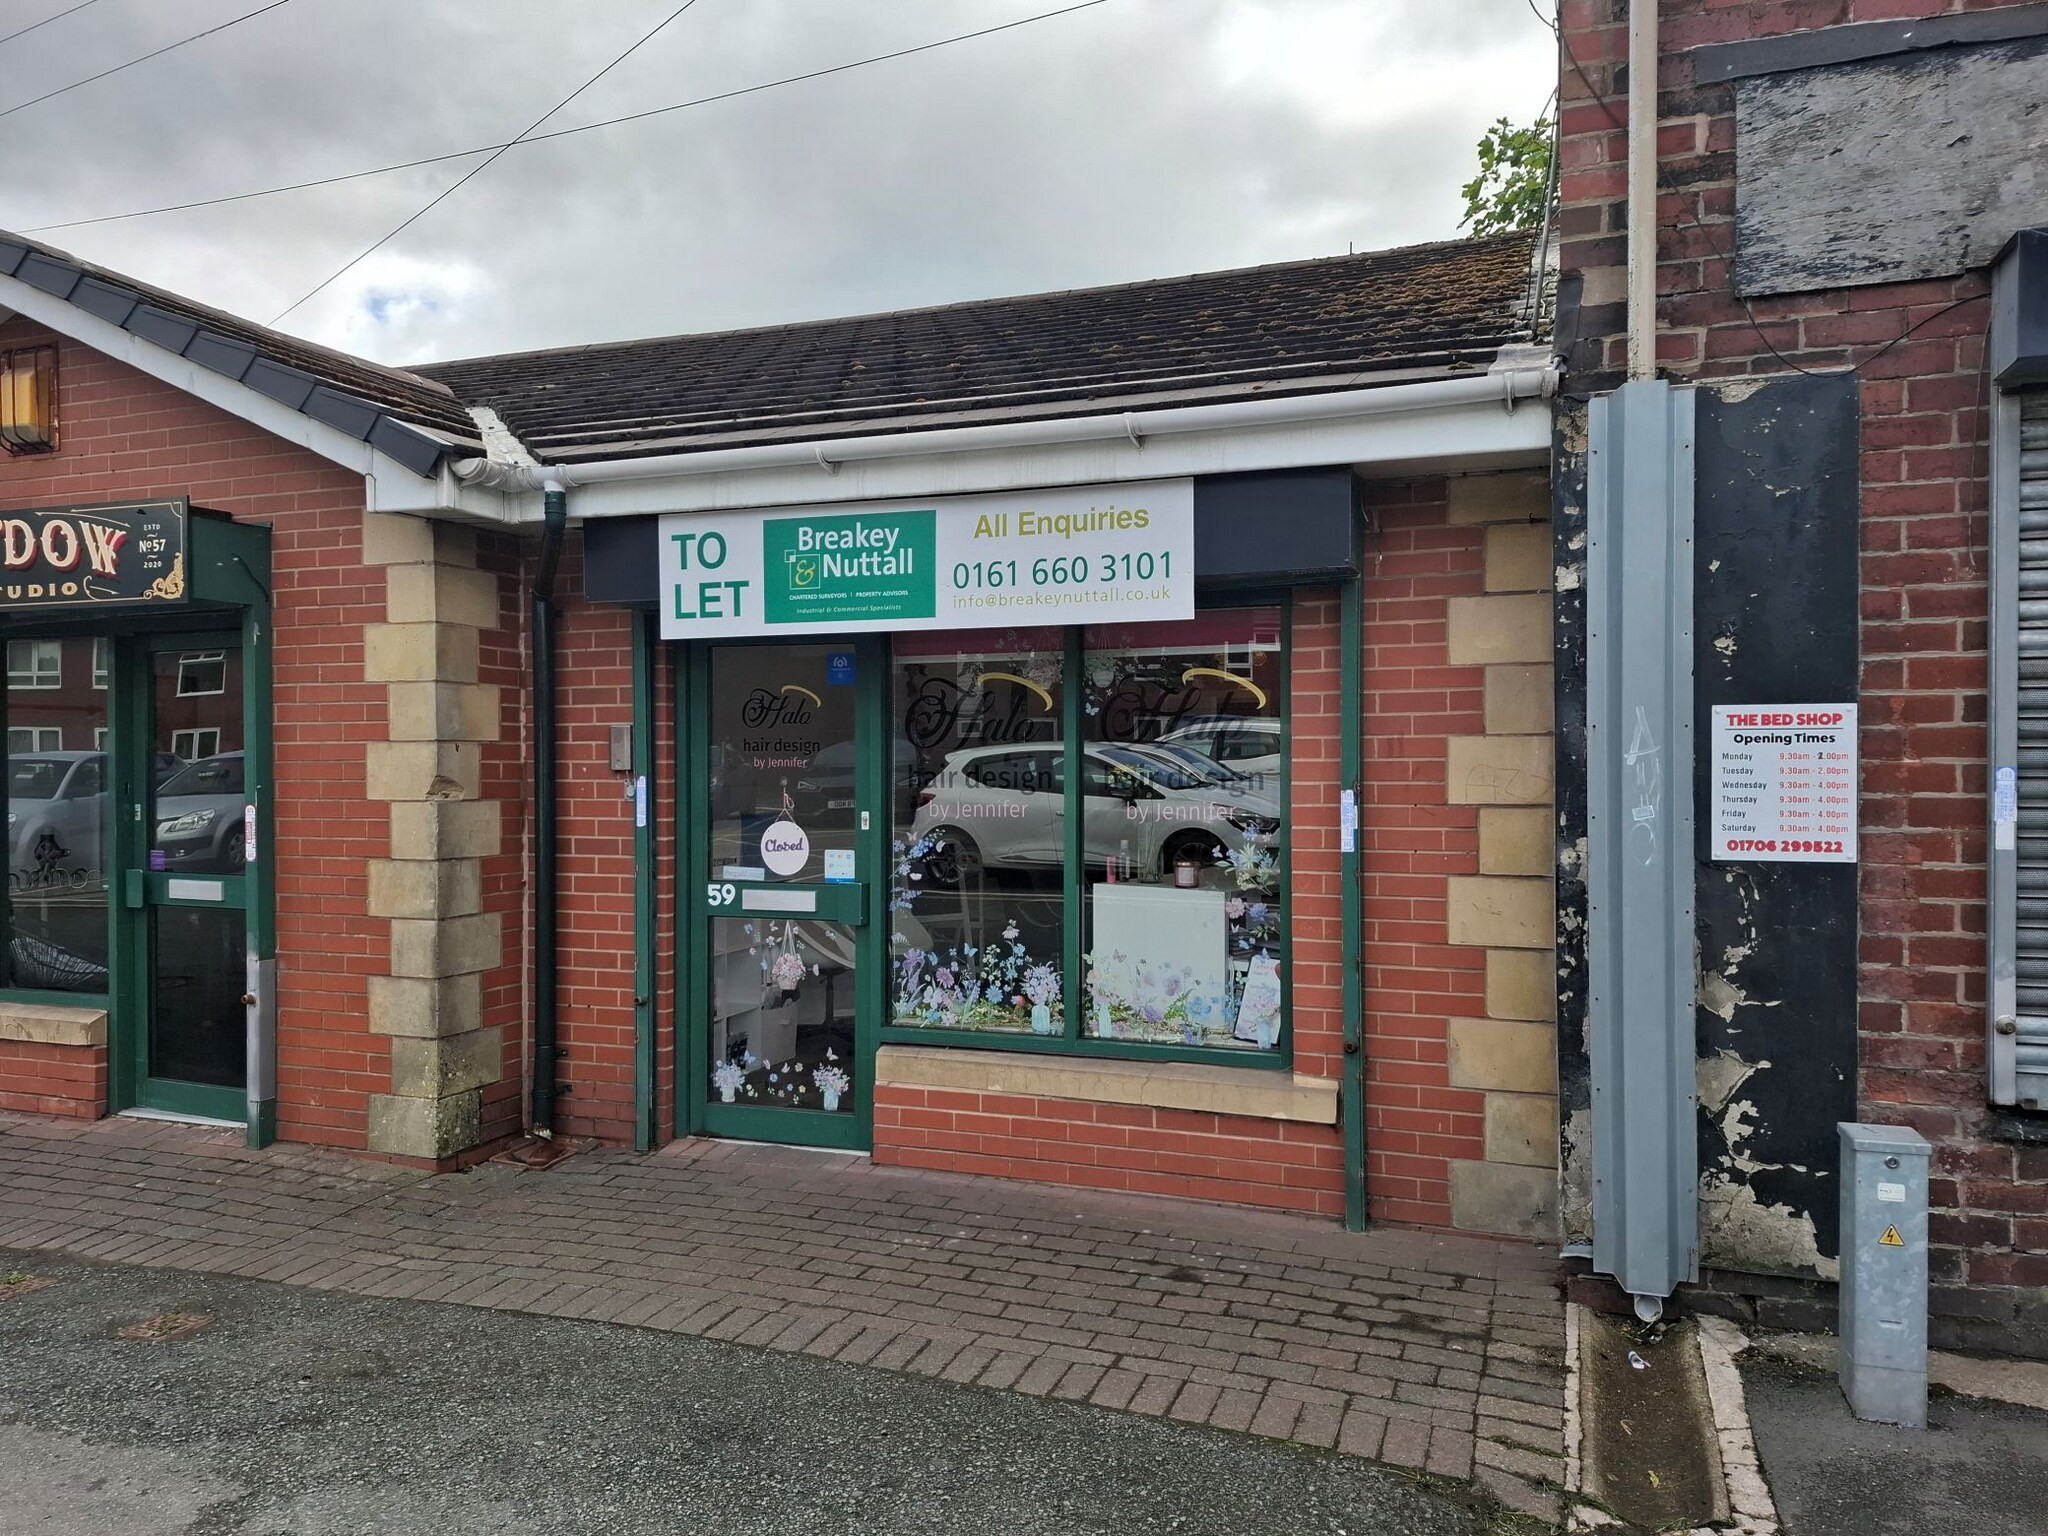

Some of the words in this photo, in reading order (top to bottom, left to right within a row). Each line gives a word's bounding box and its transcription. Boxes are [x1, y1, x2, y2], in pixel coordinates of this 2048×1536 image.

[973, 513, 1008, 539] All
[1018, 505, 1150, 539] Enquiries
[0, 519, 126, 576] DOW
[798, 521, 900, 554] Breakey
[671, 531, 727, 570] TO
[143, 560, 162, 569] 2020
[795, 559, 816, 586] &
[823, 548, 913, 578] Nuttall
[953, 560, 1017, 589] 0161
[1032, 555, 1089, 586] 660
[1100, 551, 1171, 582] 3101
[0, 582, 78, 599] UDIO
[674, 580, 750, 620] LET
[789, 593, 818, 601] CHARTERED
[818, 592, 848, 600] SURVEYORS
[855, 591, 881, 599] PROPERTY
[882, 589, 909, 597] ADVISORS
[953, 585, 1171, 609] info@breakeynuttall.co.uk
[833, 605, 869, 613] Commercial
[869, 604, 901, 613] Specialists
[742, 688, 813, 729] Halo
[904, 677, 1044, 749] Halo
[1101, 674, 1253, 745] Halo
[1726, 714, 1759, 726] THE
[1761, 713, 1794, 726] BED
[1796, 713, 1843, 726] SHOP
[743, 737, 771, 752] hair
[774, 738, 820, 757] design
[1733, 733, 1793, 745] Opening
[1794, 733, 1836, 744] Times
[753, 757, 766, 770] by
[767, 756, 809, 769] Jennifer
[1722, 752, 1753, 761] Monday
[1779, 752, 1810, 760] 9.30am
[908, 764, 955, 788] hair
[964, 765, 1053, 796] design
[1104, 764, 1158, 789] hair
[1166, 765, 1265, 796] design
[1722, 767, 1754, 775] Tuesday
[1817, 767, 1849, 775] 2.00pm
[1722, 782, 1767, 790] Wednesday
[1817, 782, 1849, 790] 4.00pm
[928, 800, 950, 821] by
[955, 799, 1029, 820] Jennifer
[1722, 796, 1758, 804] Thursday
[1817, 796, 1849, 804] 4.00pm
[1126, 801, 1148, 823] by
[1153, 800, 1237, 822] Jennifer
[1722, 810, 1747, 818] Friday
[1817, 811, 1849, 819] 4.00pm
[1722, 824, 1757, 833] Saturday
[1779, 825, 1810, 833] 9.30am
[1817, 825, 1849, 834] 4.00pm
[765, 837, 804, 853] Closed
[1726, 839, 1777, 852] 01706
[1781, 840, 1843, 853] 299522
[707, 883, 736, 906] 59
